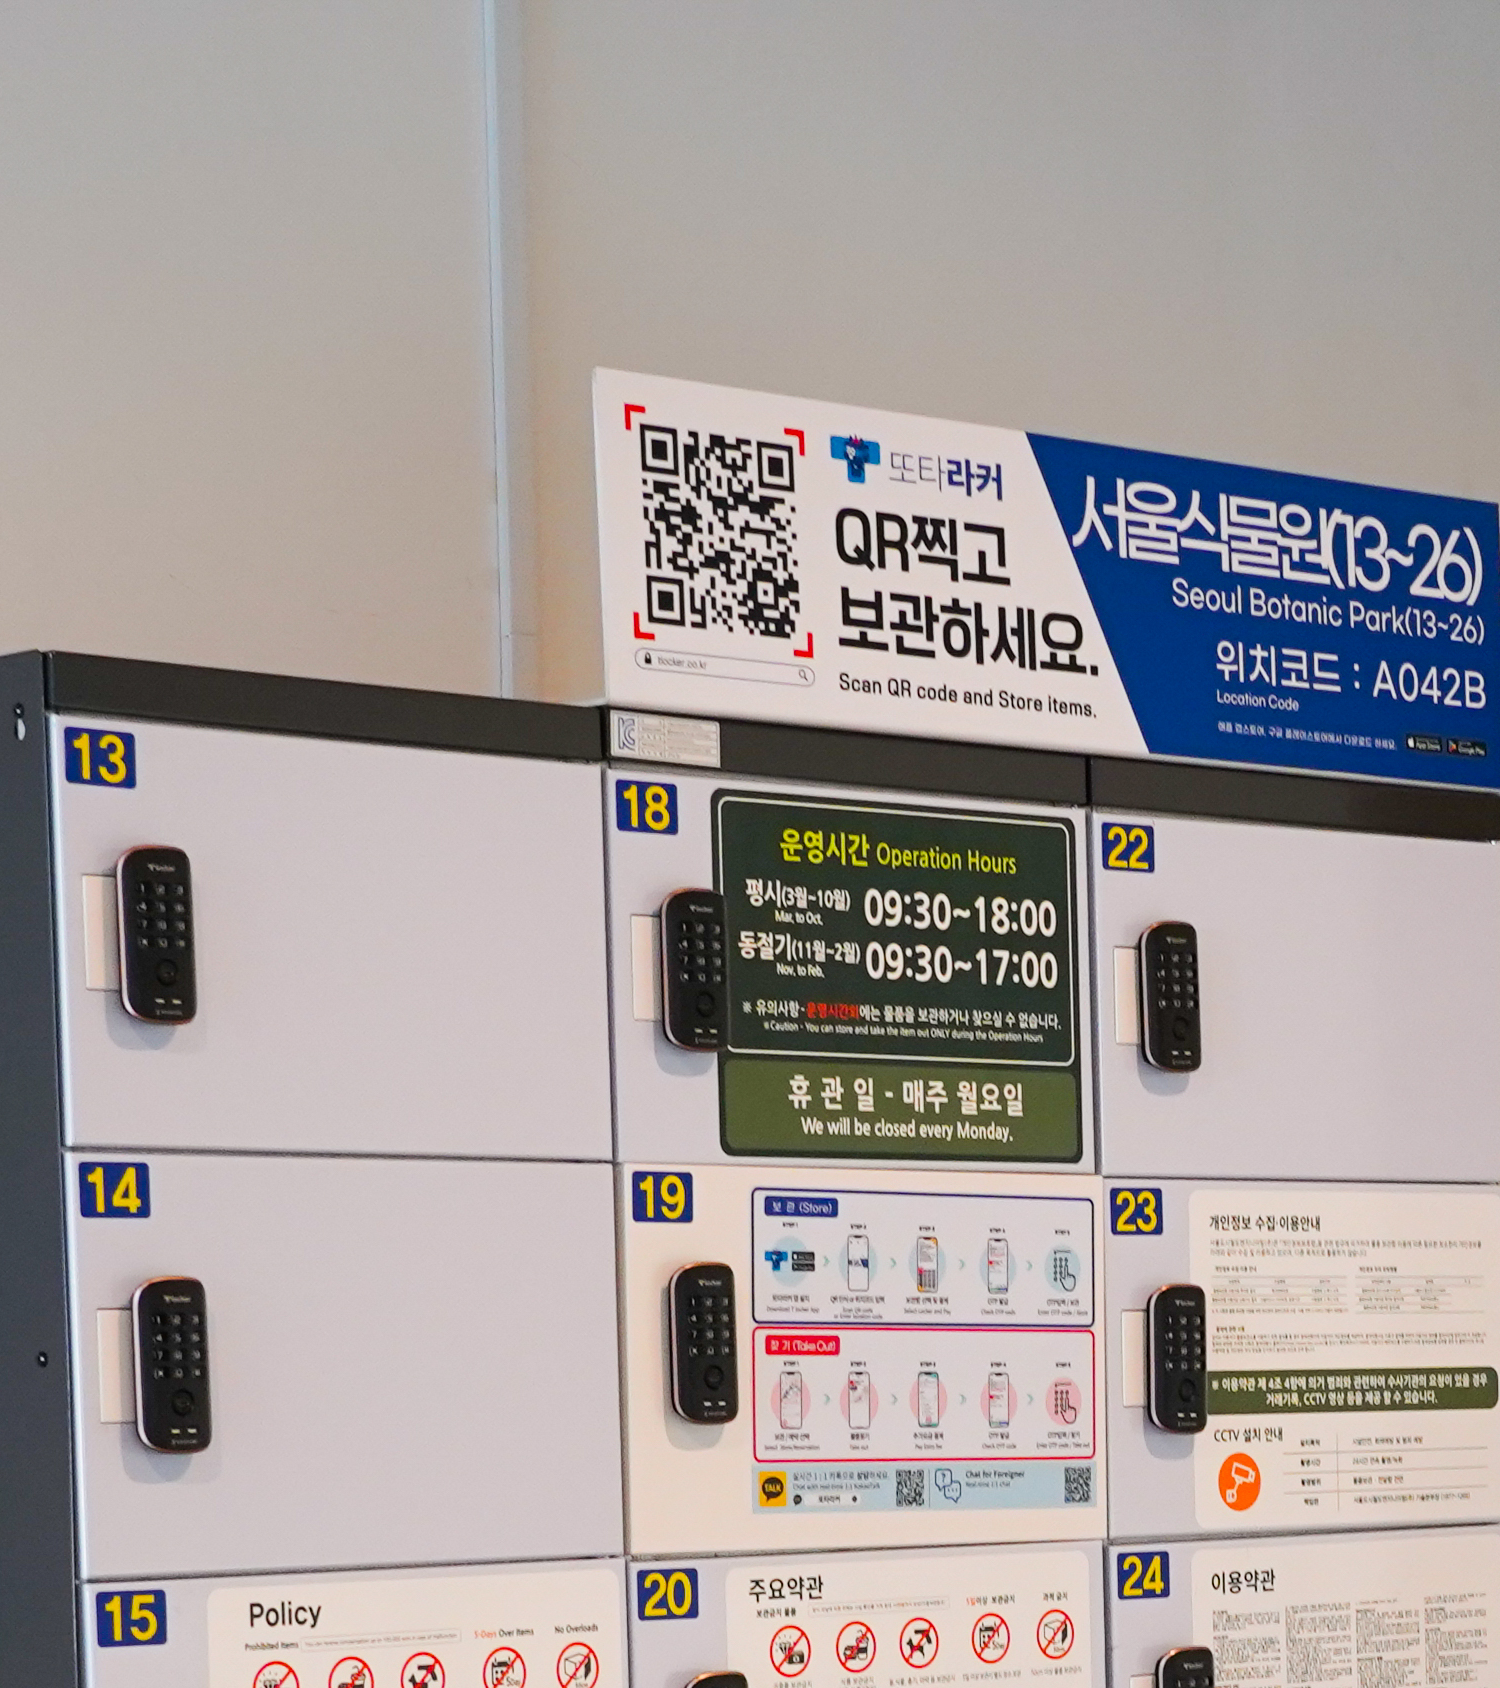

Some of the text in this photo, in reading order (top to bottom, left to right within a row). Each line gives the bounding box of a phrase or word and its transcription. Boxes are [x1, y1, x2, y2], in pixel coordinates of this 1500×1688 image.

[889, 452, 1002, 501] 또타라커
[835, 508, 1011, 586] QR찍고
[1071, 475, 1483, 606] 서울식물원(13~26)
[838, 586, 1099, 676] 보관하세요.
[1172, 577, 1485, 645] Seoul Botanic Park(13~26)
[1215, 639, 1487, 709] 위치코드 A042B
[839, 673, 1097, 719] Scan QR code and Store items.
[1216, 689, 1299, 712] Location Code
[72, 732, 128, 785] 13
[622, 784, 671, 831] 18
[780, 828, 1017, 875] 운영시간 Operation Hours
[1107, 826, 1149, 870] 22
[745, 878, 1058, 937] 평시(3월~10월) 09:30~18:00
[795, 912, 805, 924] to
[797, 964, 806, 977] to
[865, 941, 1059, 989] 09:30~17:00
[770, 1020, 1044, 1043] Caution You can store and take the item out ONLY during the Operation Hours
[883, 1004, 915, 1024] 물품을
[918, 1006, 969, 1026] 보관하거나
[972, 1009, 1003, 1028] 찾으실
[1005, 1012, 1016, 1028] 수
[1018, 1012, 1062, 1030] 없습니다.
[902, 1079, 949, 1114] 매주
[957, 1081, 1024, 1117] 월요일
[801, 1116, 1014, 1142] We will be closed every Monday.
[85, 1167, 143, 1214] 14
[639, 1175, 686, 1219] 19
[1116, 1191, 1158, 1233] 23
[1209, 1215, 1251, 1231] 개인정보
[1222, 1372, 1488, 1391] 이용약관 제 4조 4항에 의거 범죄와 관련하여 수사기관의 요청이 있을 경우
[1266, 1390, 1438, 1407] 거래기록, CCTV 영상 등을 제공 할 수 있습니다.
[1214, 1429, 1240, 1442] CCTV
[1243, 1427, 1261, 1442] 설치
[1264, 1427, 1283, 1442] 안내
[764, 1482, 781, 1492] TALK
[643, 1571, 693, 1617] 20
[749, 1575, 823, 1603] 주요약관
[1122, 1555, 1164, 1597] 24
[1211, 1568, 1276, 1594] 이용약관
[104, 1594, 158, 1642] 15
[249, 1601, 322, 1629] Policy
[554, 1623, 599, 1634] No Overloads
